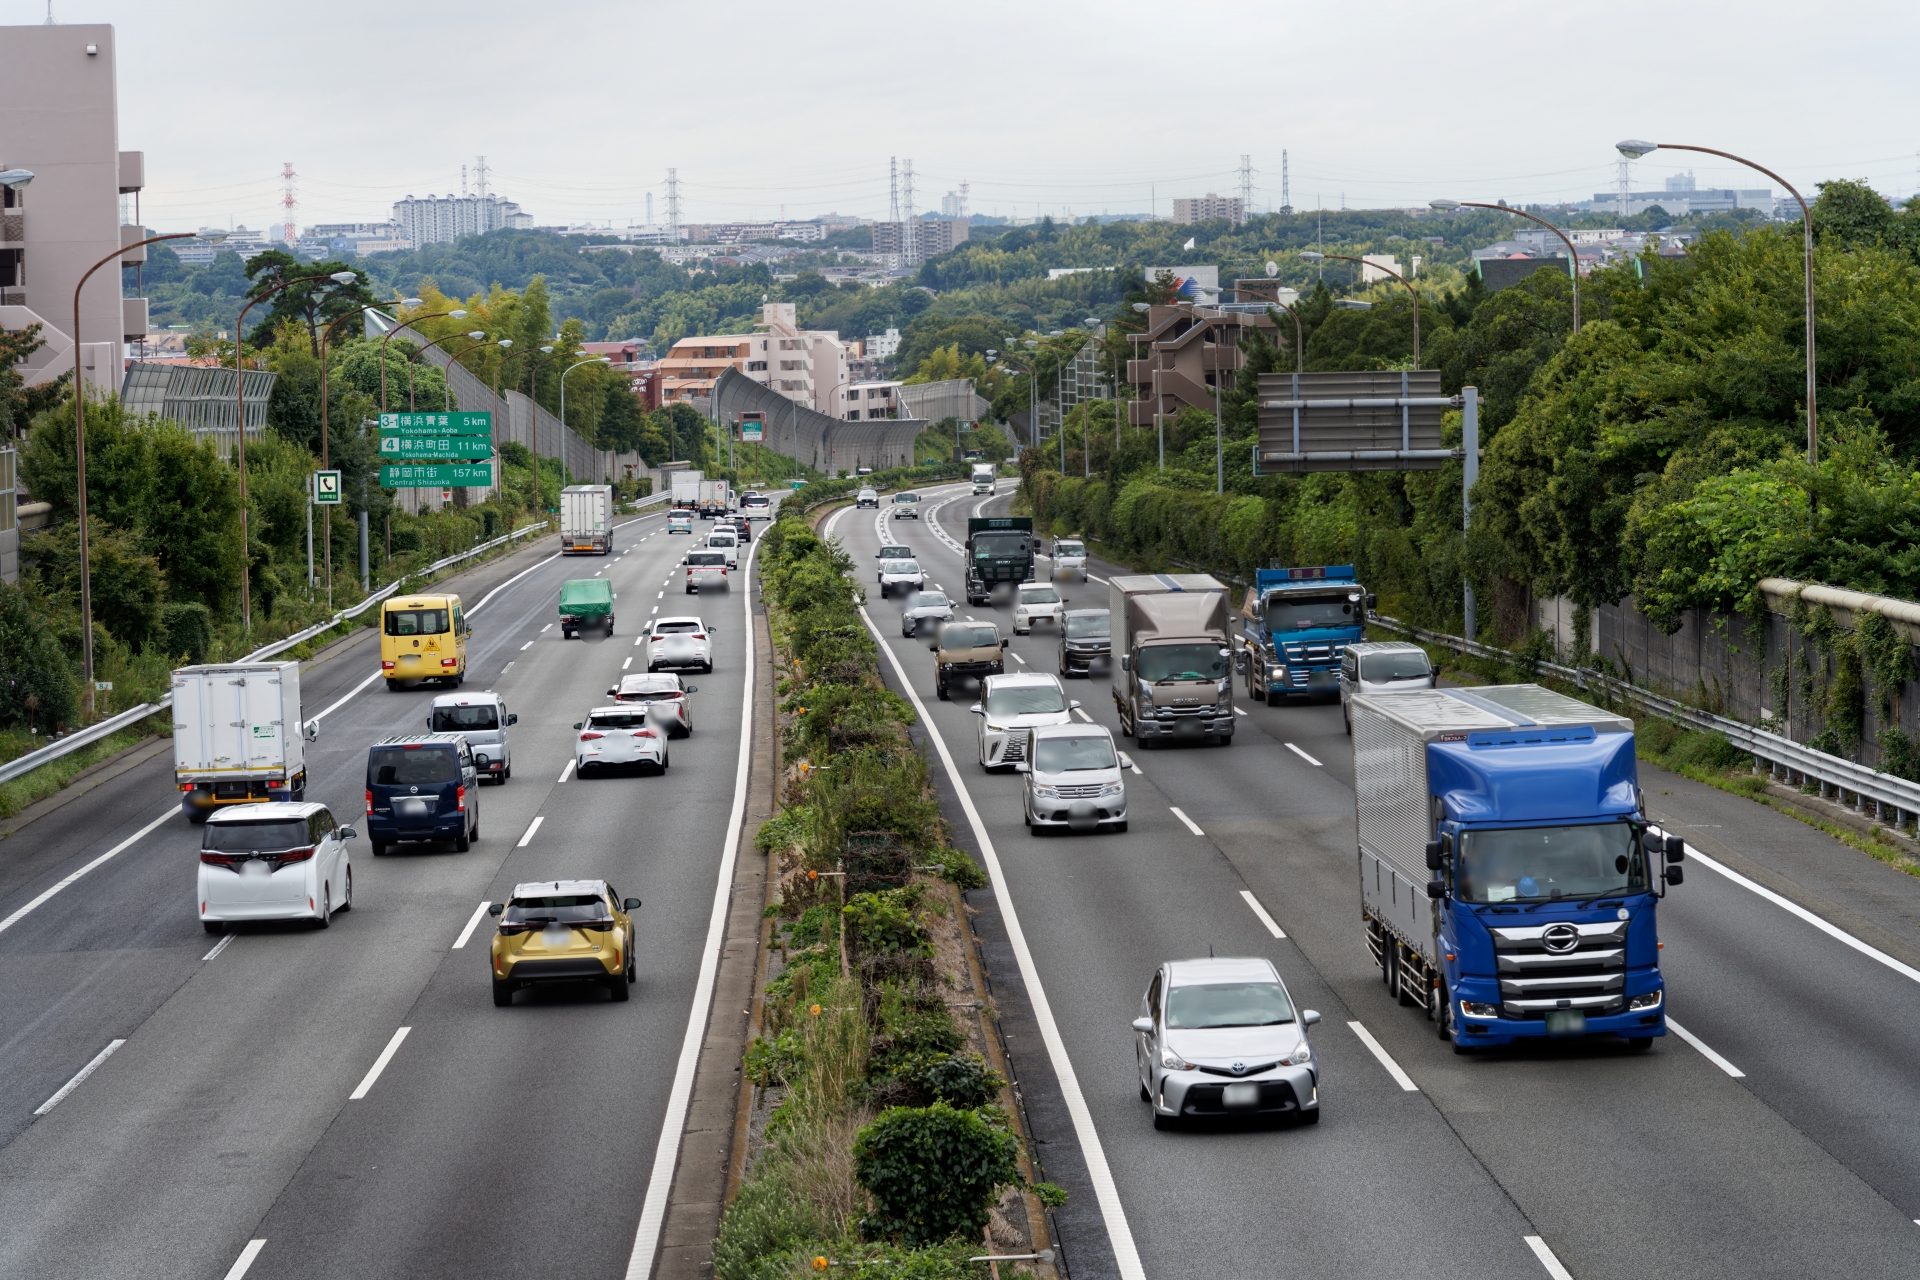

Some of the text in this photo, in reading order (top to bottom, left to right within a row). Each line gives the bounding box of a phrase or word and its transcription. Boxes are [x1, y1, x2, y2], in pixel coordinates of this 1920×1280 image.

[400, 415, 448, 426] 横浜青葉
[463, 417, 470, 426] 5
[471, 417, 486, 426] km
[386, 439, 486, 450] 4 横浜町田 11 km
[389, 467, 487, 478] 静岡市街 157 km
